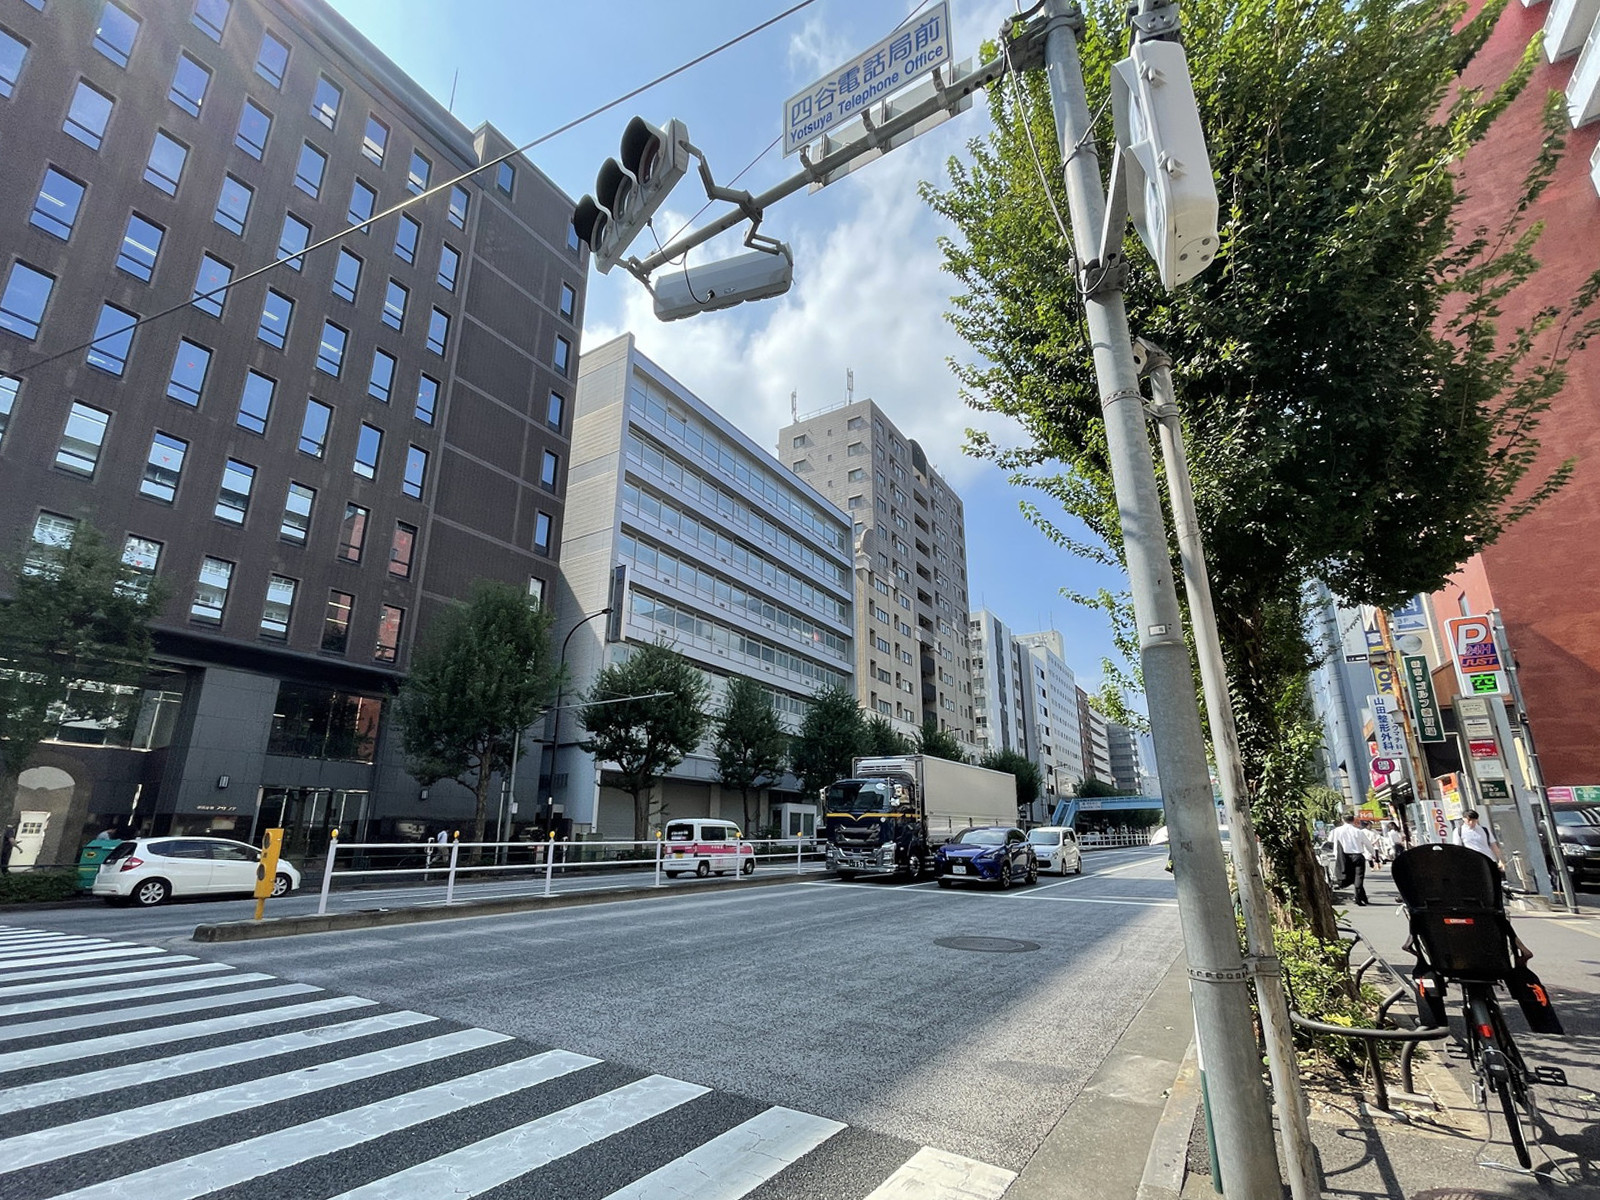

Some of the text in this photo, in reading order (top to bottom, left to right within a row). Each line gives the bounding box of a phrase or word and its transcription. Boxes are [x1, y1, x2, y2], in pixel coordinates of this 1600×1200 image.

[791, 16, 940, 128] 四谷電話局前
[790, 45, 943, 144] Yotsuya Telephone Office
[1457, 623, 1487, 655] P
[1461, 656, 1496, 667] JUST
[1470, 674, 1498, 694] 空
[1374, 697, 1394, 751] 山田整形外科
[1435, 809, 1449, 837] DyDo
